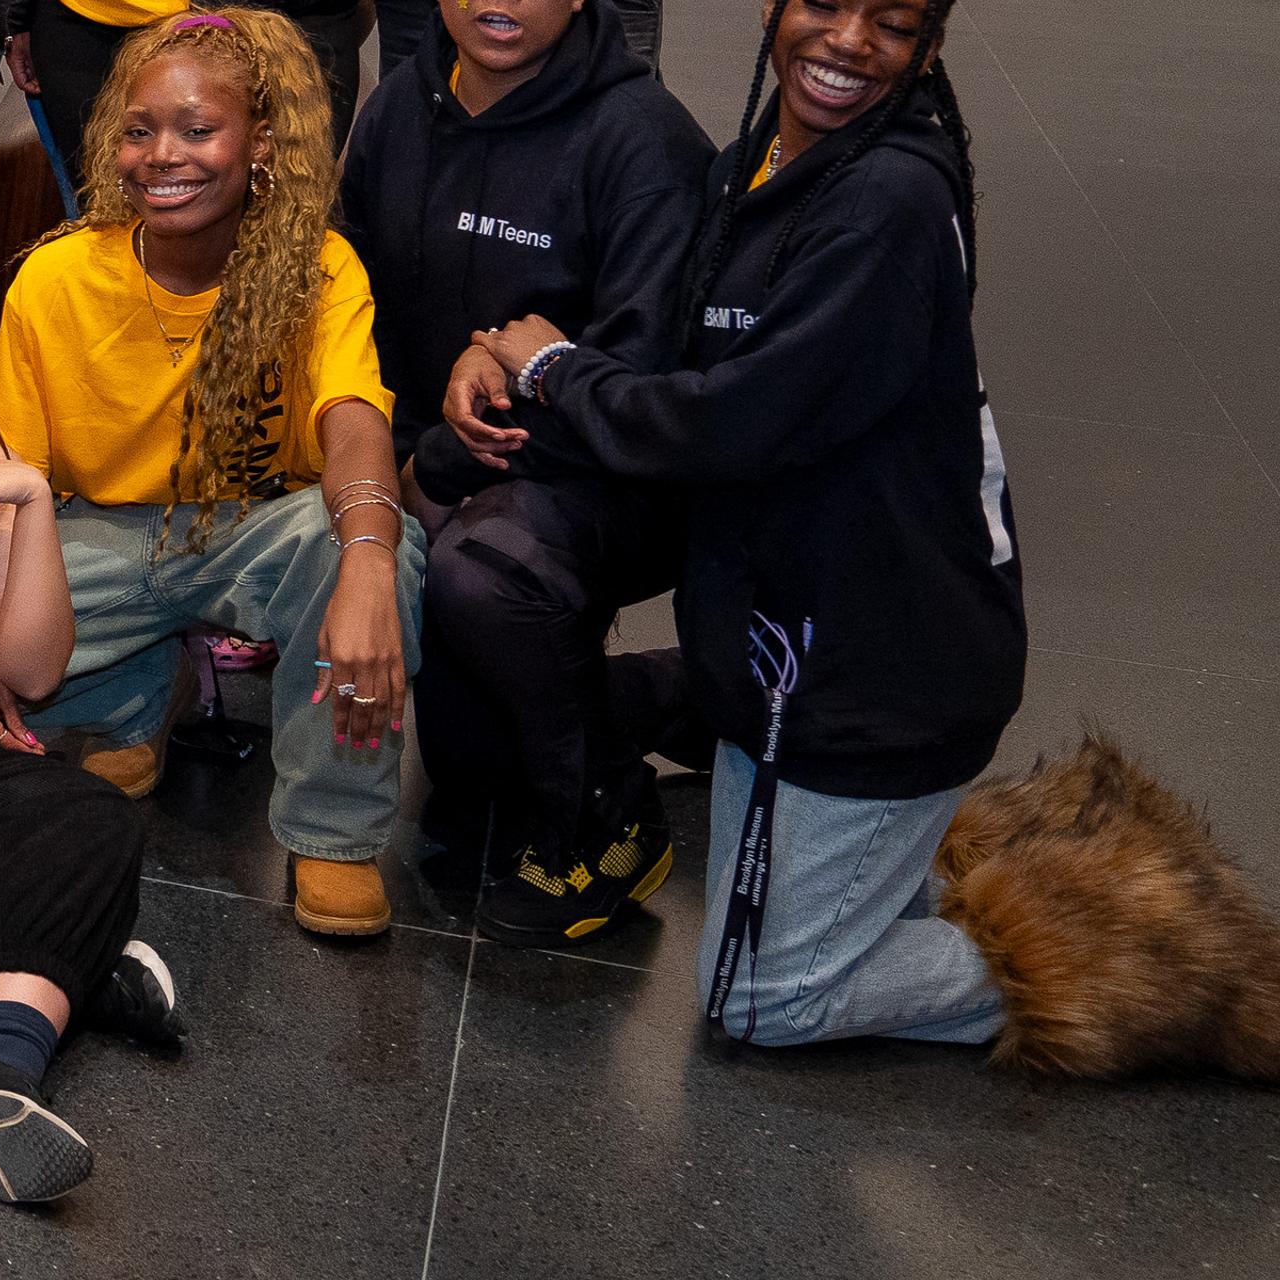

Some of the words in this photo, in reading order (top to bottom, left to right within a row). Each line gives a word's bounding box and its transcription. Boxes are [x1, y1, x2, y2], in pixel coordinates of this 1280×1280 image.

[497, 219, 552, 249] Teens
[704, 306, 730, 329] BkM
[770, 689, 782, 715] Mus
[764, 714, 782, 762] Brooklyn
[737, 850, 755, 895] Brooklyn
[746, 806, 763, 851] Museum
[720, 937, 737, 977] Museum
[711, 976, 730, 1018] Brooklyn
